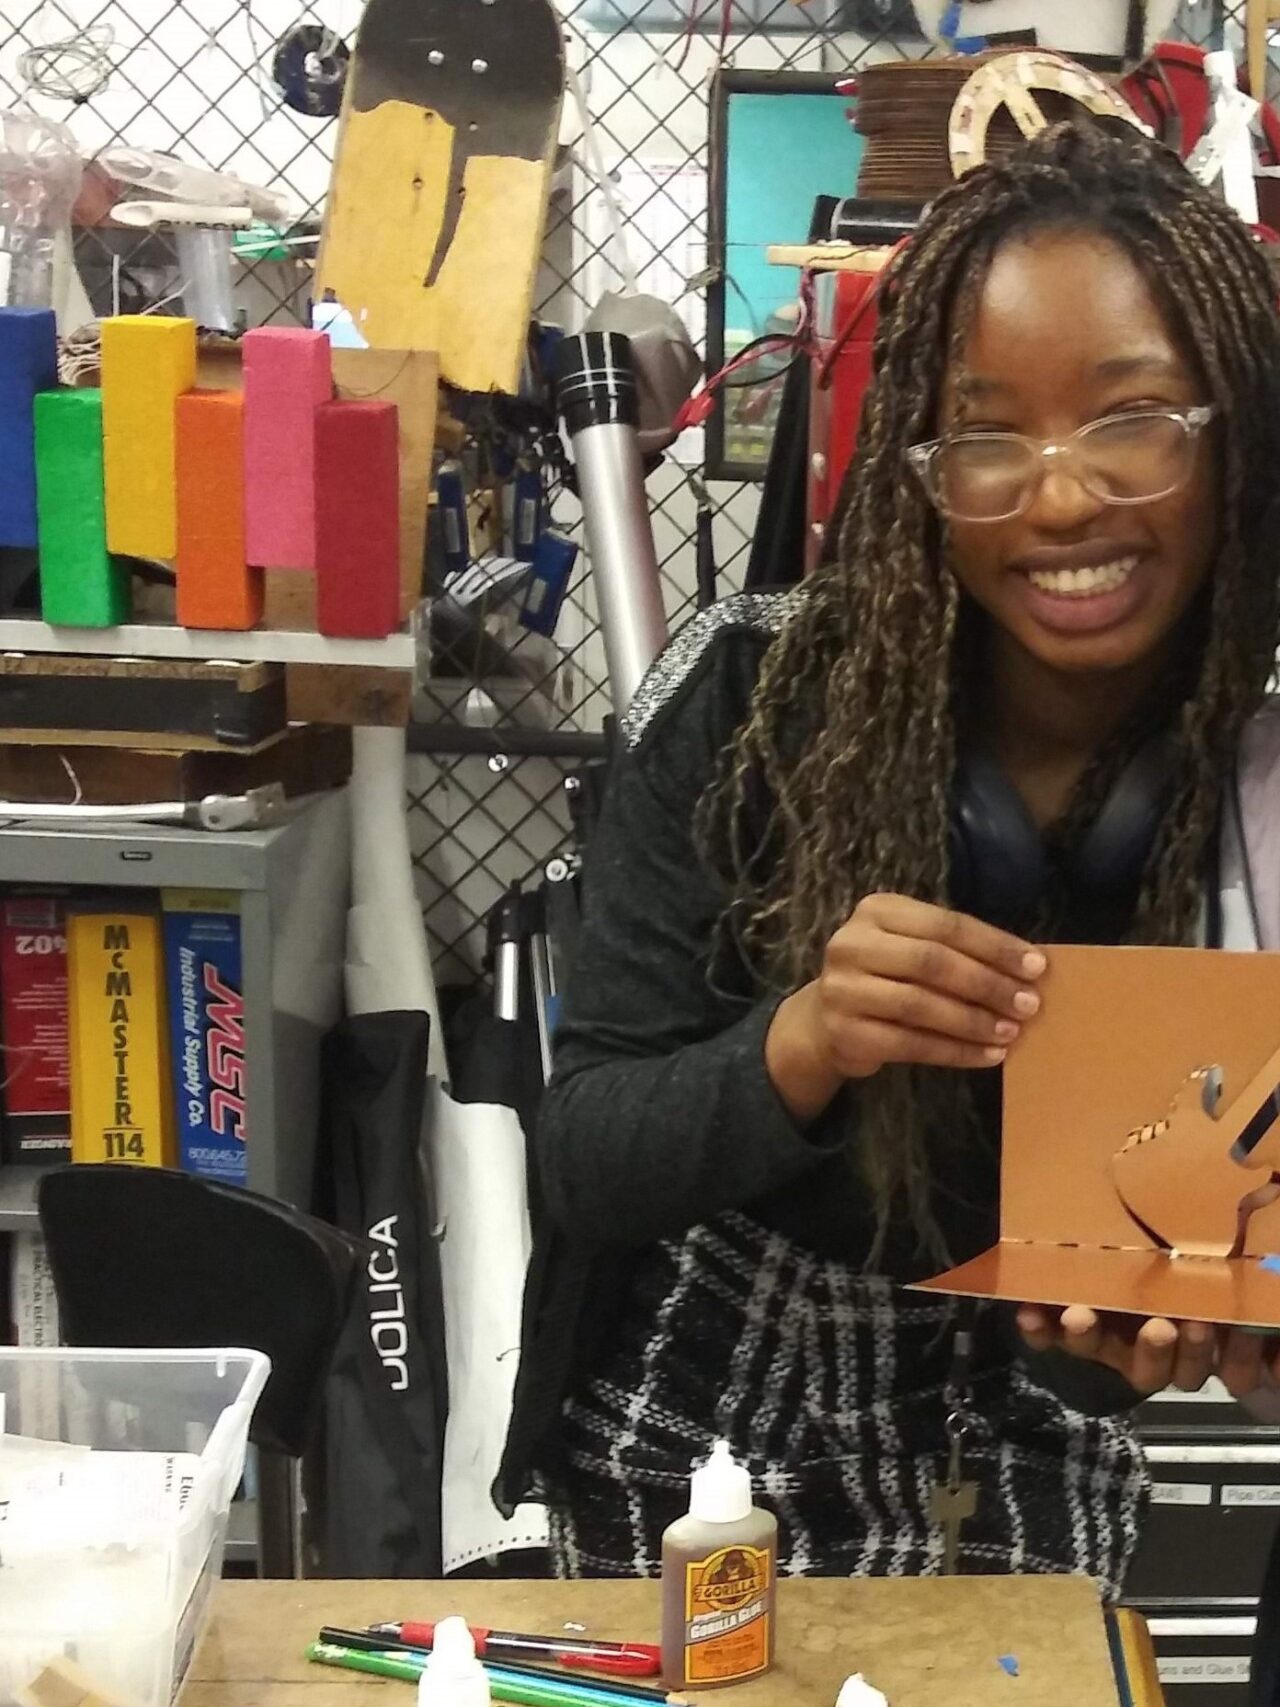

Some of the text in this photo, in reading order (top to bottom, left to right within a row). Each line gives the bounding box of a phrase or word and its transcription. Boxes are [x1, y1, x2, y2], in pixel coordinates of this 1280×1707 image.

[179, 946, 206, 1128] Industrial Supply Co.
[203, 961, 247, 1143] MSC
[102, 1132, 145, 1158] 114
[368, 1214, 409, 1391] JOLICA
[704, 1579, 756, 1597] GORILLA
